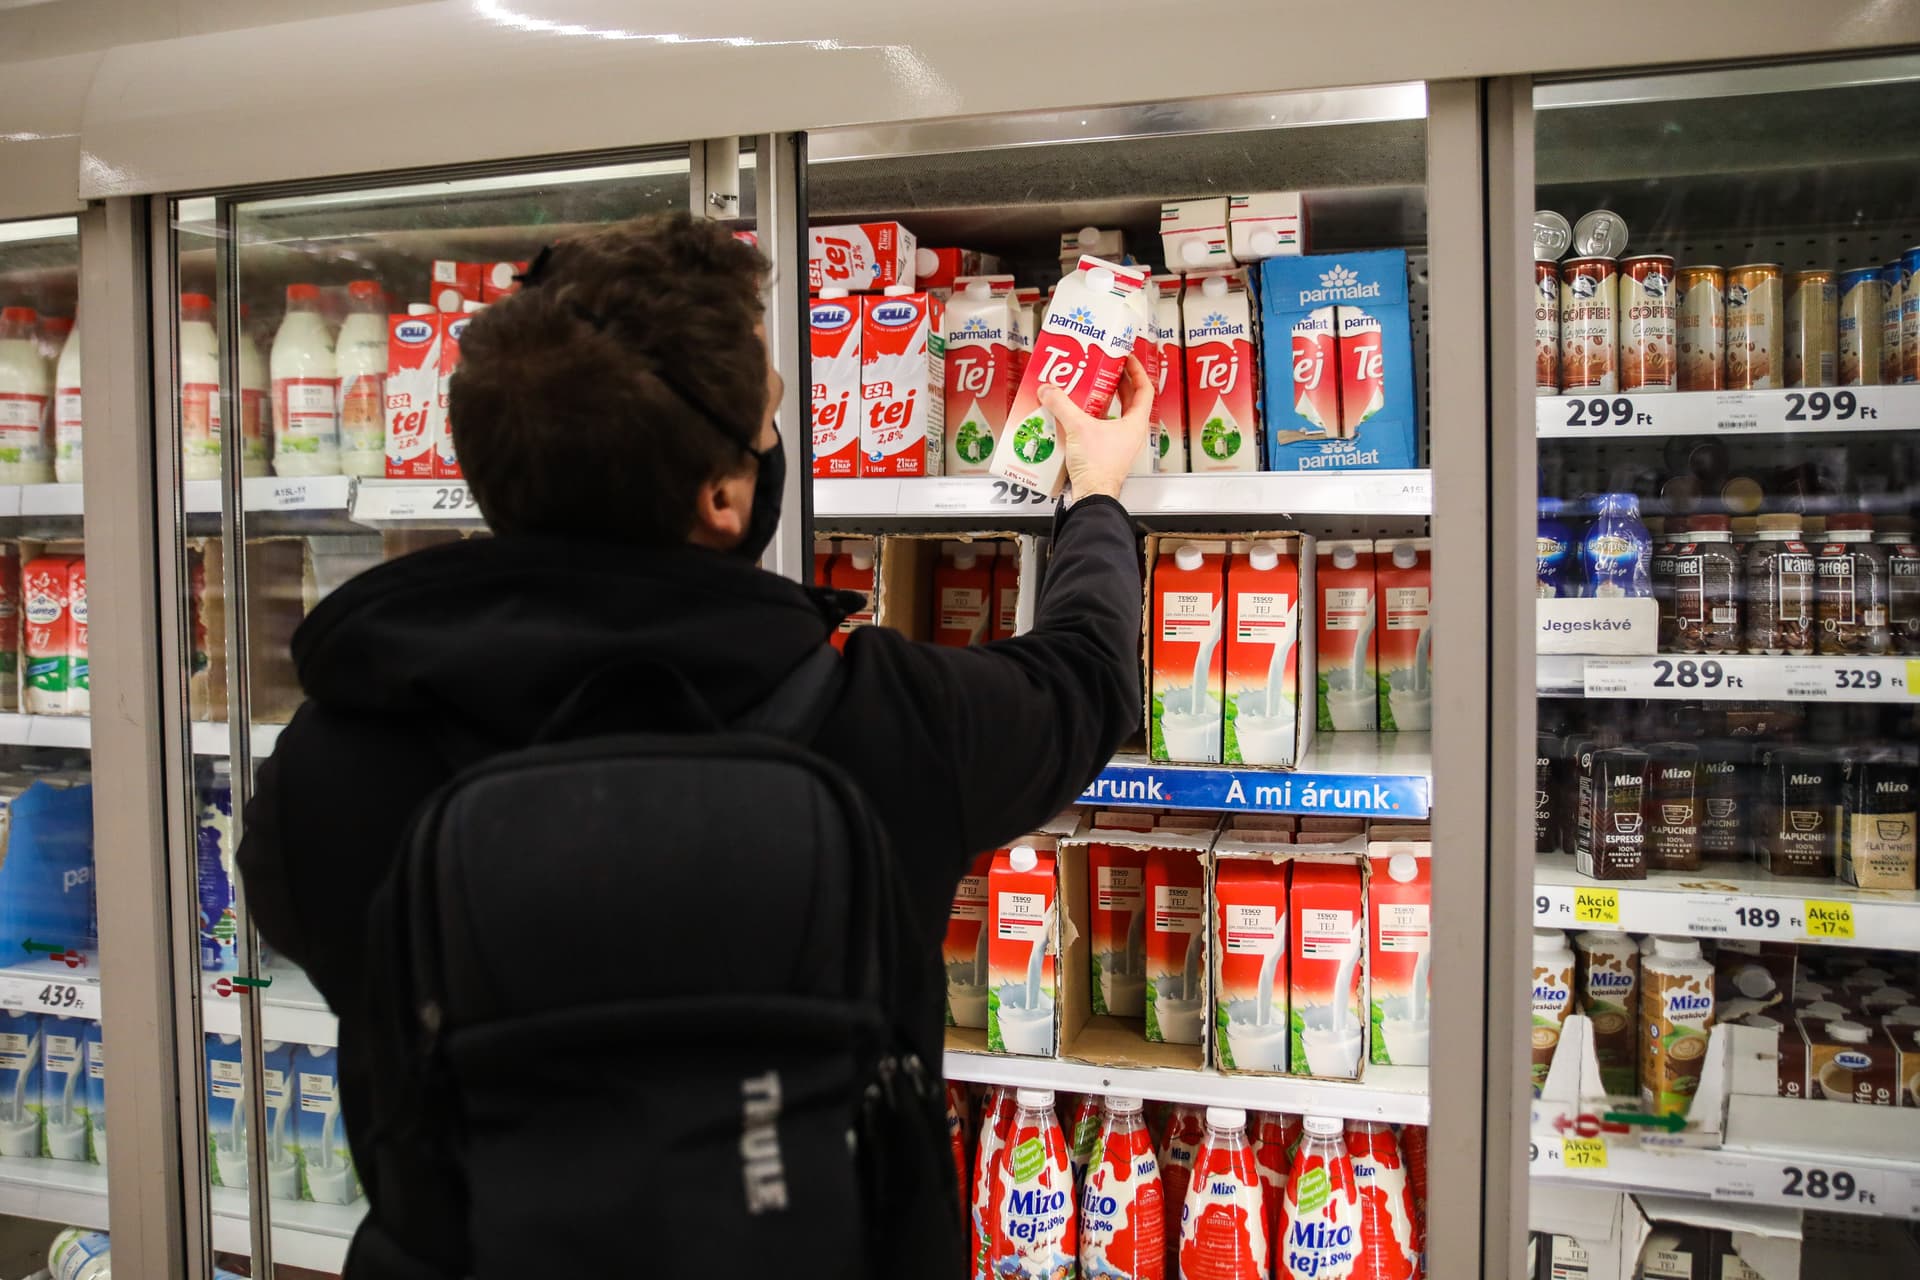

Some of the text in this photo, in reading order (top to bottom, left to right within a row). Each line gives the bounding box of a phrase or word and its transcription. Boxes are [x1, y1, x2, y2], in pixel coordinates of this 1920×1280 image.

[815, 236, 851, 280] tej
[1300, 281, 1380, 306] parmalat
[949, 328, 1002, 343] parmalat
[1049, 313, 1107, 341] parmalat
[1189, 324, 1244, 338] parmalat
[955, 358, 996, 398] Tej
[1037, 346, 1088, 396] Tej
[1196, 352, 1238, 395] Tej
[865, 383, 891, 398] ESL
[869, 389, 916, 429] tej
[1566, 398, 1652, 426] 299 Ft
[1784, 391, 1877, 421] 299 Ft
[392, 401, 430, 436] tej
[877, 430, 903, 444] 2,8%
[1299, 449, 1379, 471] parmalat
[1542, 618, 1632, 634] Jegeskávé
[1652, 660, 1743, 688] 289 Ft
[1834, 670, 1903, 689] 329 Ft
[1614, 774, 1643, 787] Mizo
[1661, 768, 1692, 779] Mizo
[1790, 774, 1822, 786] Mizo
[1225, 780, 1400, 809] A mi árunk.
[1876, 781, 1909, 793] Mizo
[1605, 835, 1644, 843] ESPRESSO
[1559, 904, 1570, 913] Ft
[1577, 895, 1615, 908] Akció
[1735, 907, 1802, 928] 189 Ft
[1808, 907, 1850, 921] Akció
[1591, 973, 1632, 987] Mizo
[39, 984, 77, 1007] 439
[1669, 996, 1711, 1011] Mizo
[1171, 1148, 1191, 1160] Mizo
[1548, 1151, 1559, 1159] Ft
[1137, 1161, 1156, 1176] Mizo
[1210, 1181, 1236, 1196] Mizo
[1782, 1167, 1876, 1205] 289 Ft
[1008, 1189, 1065, 1215] Mizo
[1009, 1218, 1037, 1242] tej
[1289, 1220, 1353, 1249] Mizo
[1290, 1252, 1319, 1277] tej
